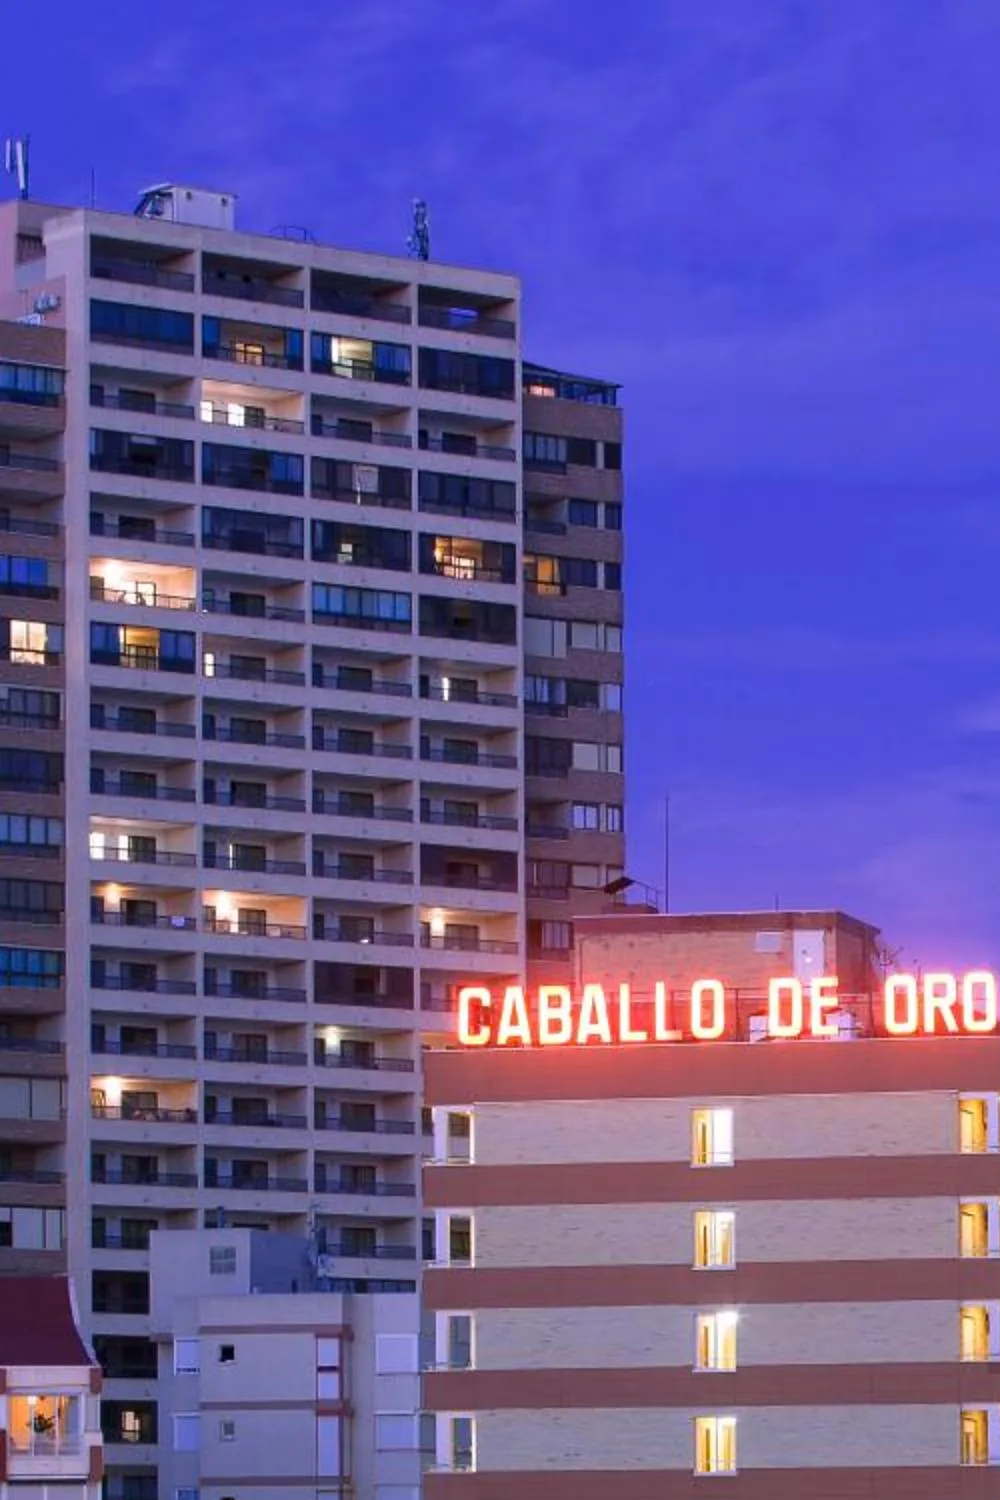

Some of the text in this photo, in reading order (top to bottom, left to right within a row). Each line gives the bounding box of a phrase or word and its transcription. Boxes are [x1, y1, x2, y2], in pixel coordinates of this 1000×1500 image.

[458, 971, 998, 1046] CABALLO DE ORO
